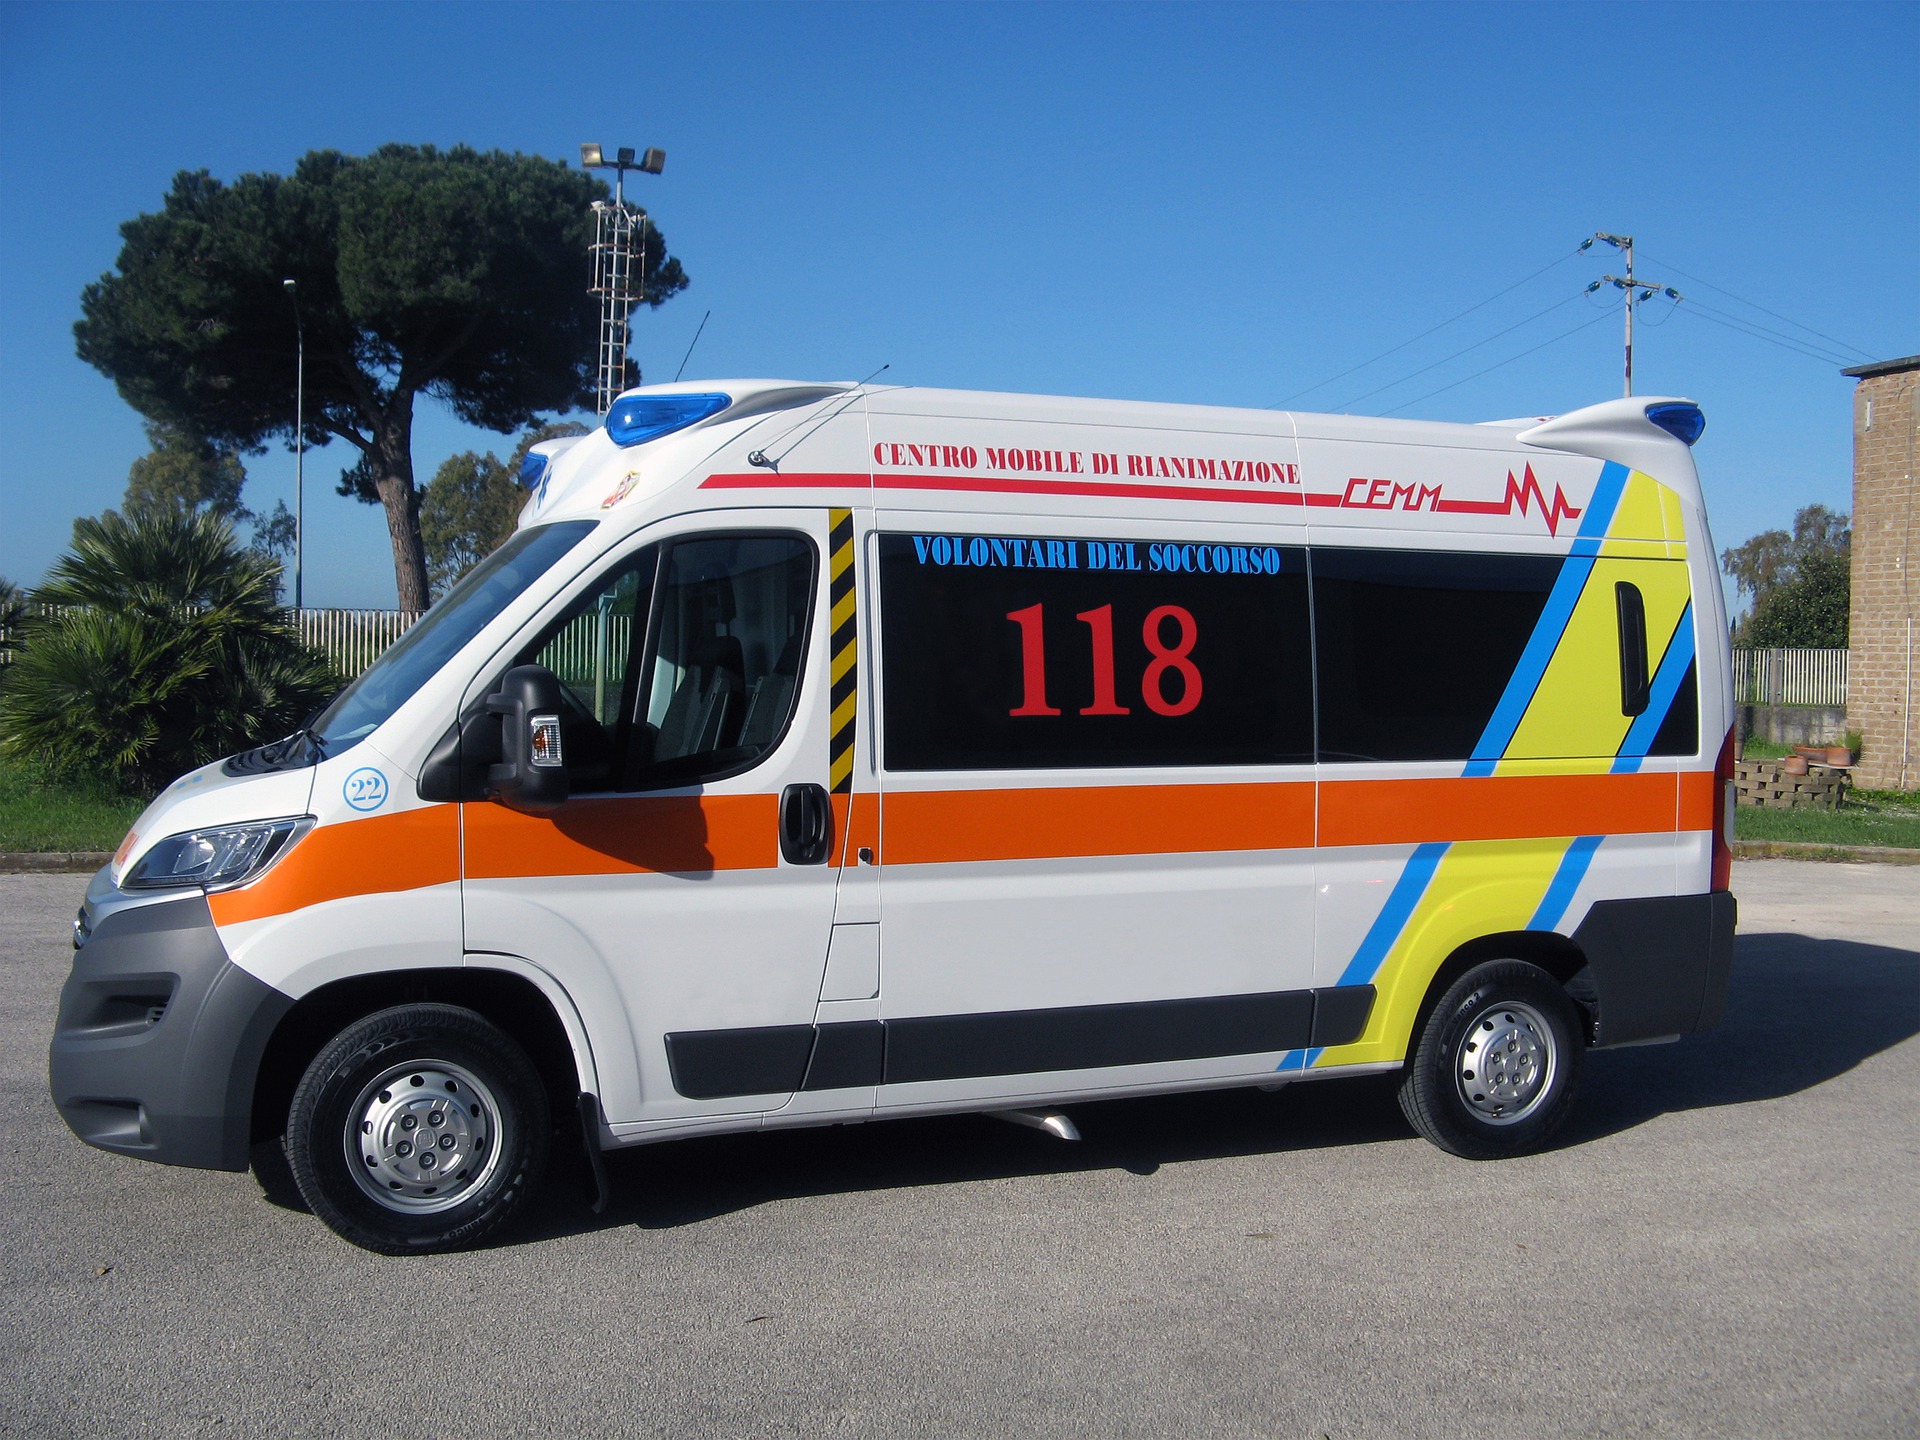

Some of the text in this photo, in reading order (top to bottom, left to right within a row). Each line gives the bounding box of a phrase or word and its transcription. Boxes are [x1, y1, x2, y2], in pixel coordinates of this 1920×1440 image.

[873, 441, 1301, 484] CENTRO MOBILE DI RIANIMAZIONE
[1340, 477, 1443, 512] CEMM
[912, 535, 1281, 575] VOLONTARI DEL SOCCORSO
[1005, 602, 1204, 717] 118
[351, 777, 382, 801] 22
